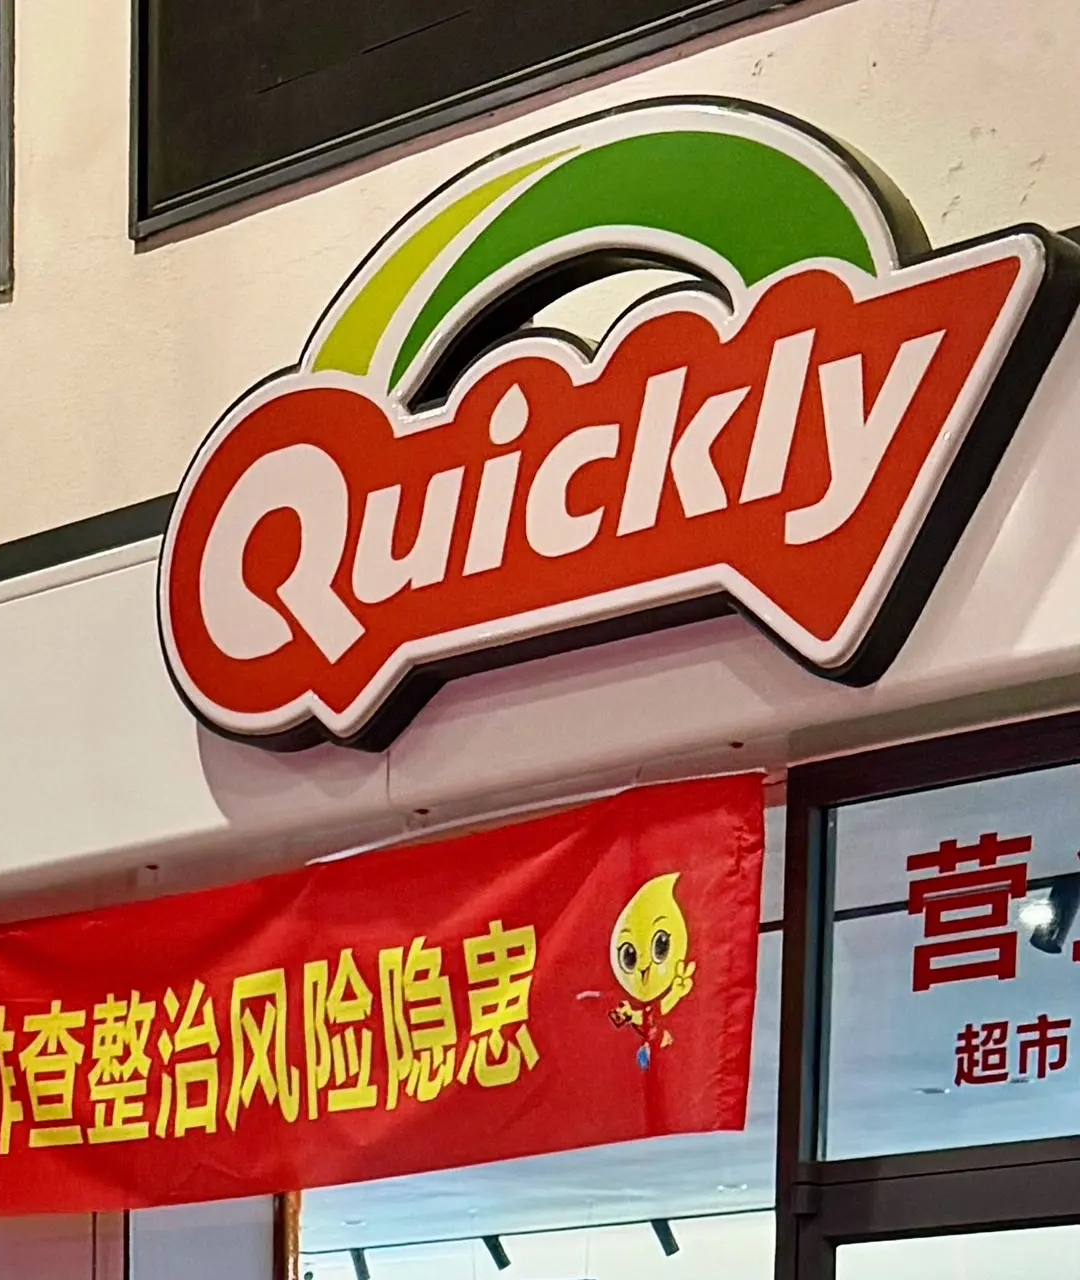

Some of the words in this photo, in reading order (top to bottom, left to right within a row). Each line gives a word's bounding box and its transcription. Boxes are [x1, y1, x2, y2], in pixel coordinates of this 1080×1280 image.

[199, 328, 945, 663] Quickly
[906, 832, 1080, 992] 营
[954, 1013, 1072, 1087] 超市
